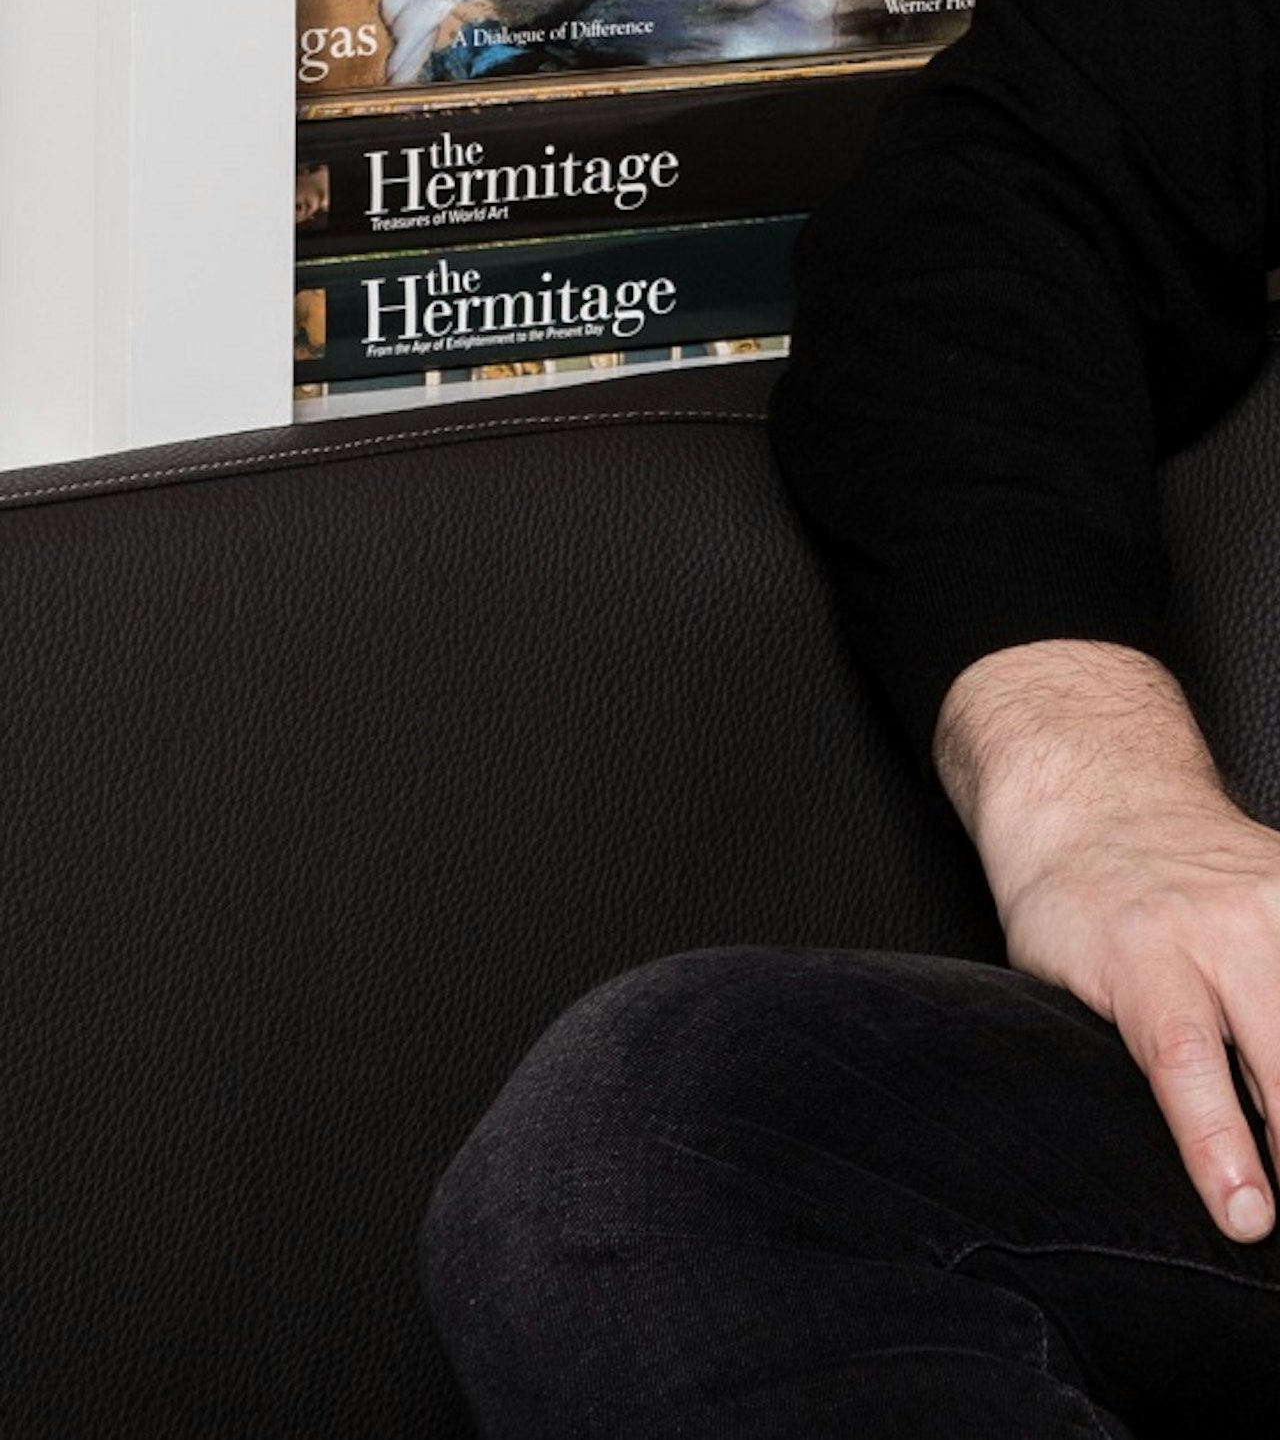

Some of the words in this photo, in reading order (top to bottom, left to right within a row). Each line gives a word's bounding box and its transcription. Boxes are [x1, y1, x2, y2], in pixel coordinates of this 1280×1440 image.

[429, 131, 484, 169] the
[364, 144, 680, 215] Hermitage
[426, 258, 481, 295] the
[361, 270, 677, 345] Hermitage
